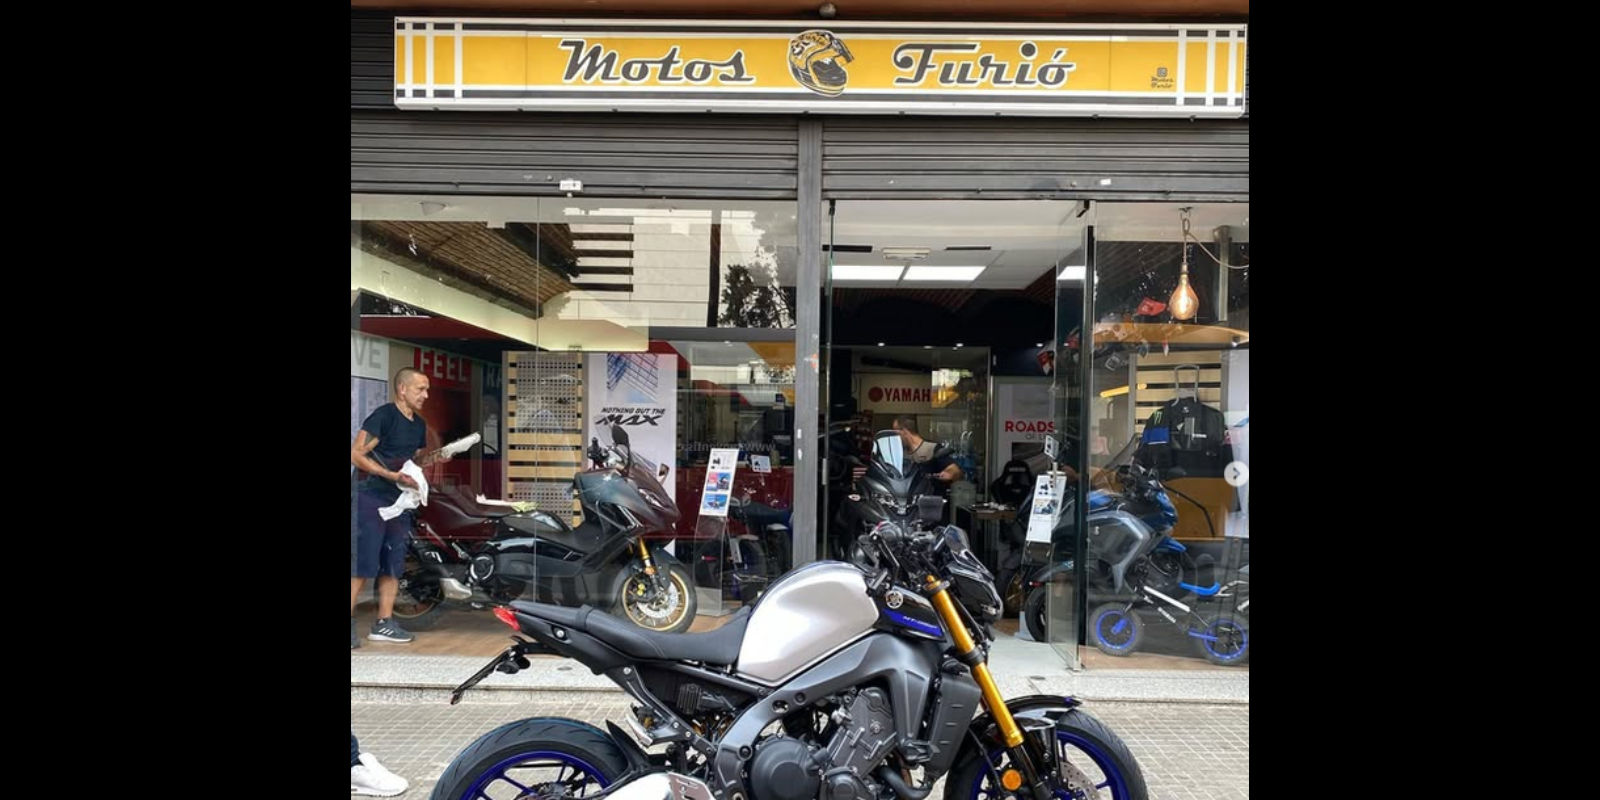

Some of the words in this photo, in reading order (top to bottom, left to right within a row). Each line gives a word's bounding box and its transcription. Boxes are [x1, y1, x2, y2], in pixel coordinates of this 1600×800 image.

[561, 40, 753, 82] Motos
[893, 42, 1074, 86] Furió
[420, 349, 467, 382] FEEL
[884, 388, 932, 402] YAMAH
[595, 413, 662, 426] MAX
[1005, 420, 1055, 433] ROADS
